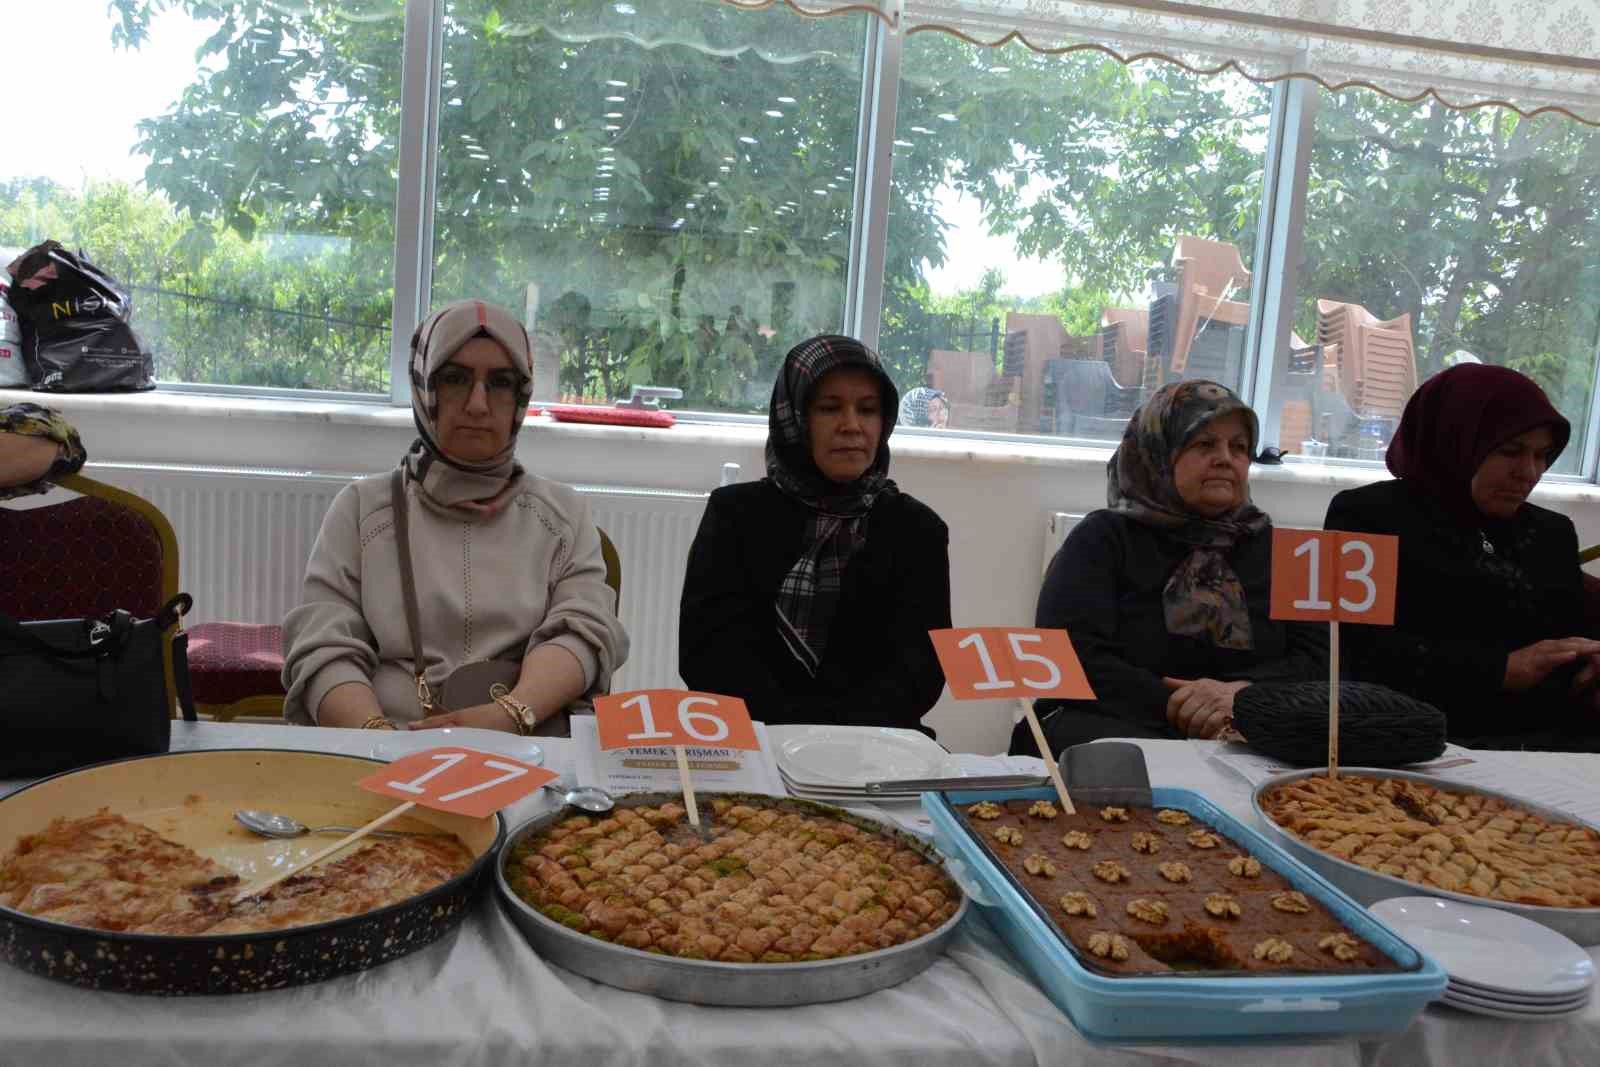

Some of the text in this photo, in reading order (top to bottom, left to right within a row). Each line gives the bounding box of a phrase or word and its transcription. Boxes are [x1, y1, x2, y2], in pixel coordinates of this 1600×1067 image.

[1293, 538, 1377, 612] 13
[958, 633, 1062, 690] 15
[621, 694, 729, 742] 16
[387, 752, 529, 802] 17
[628, 747, 730, 757] YEMEK YRIŞMASI
